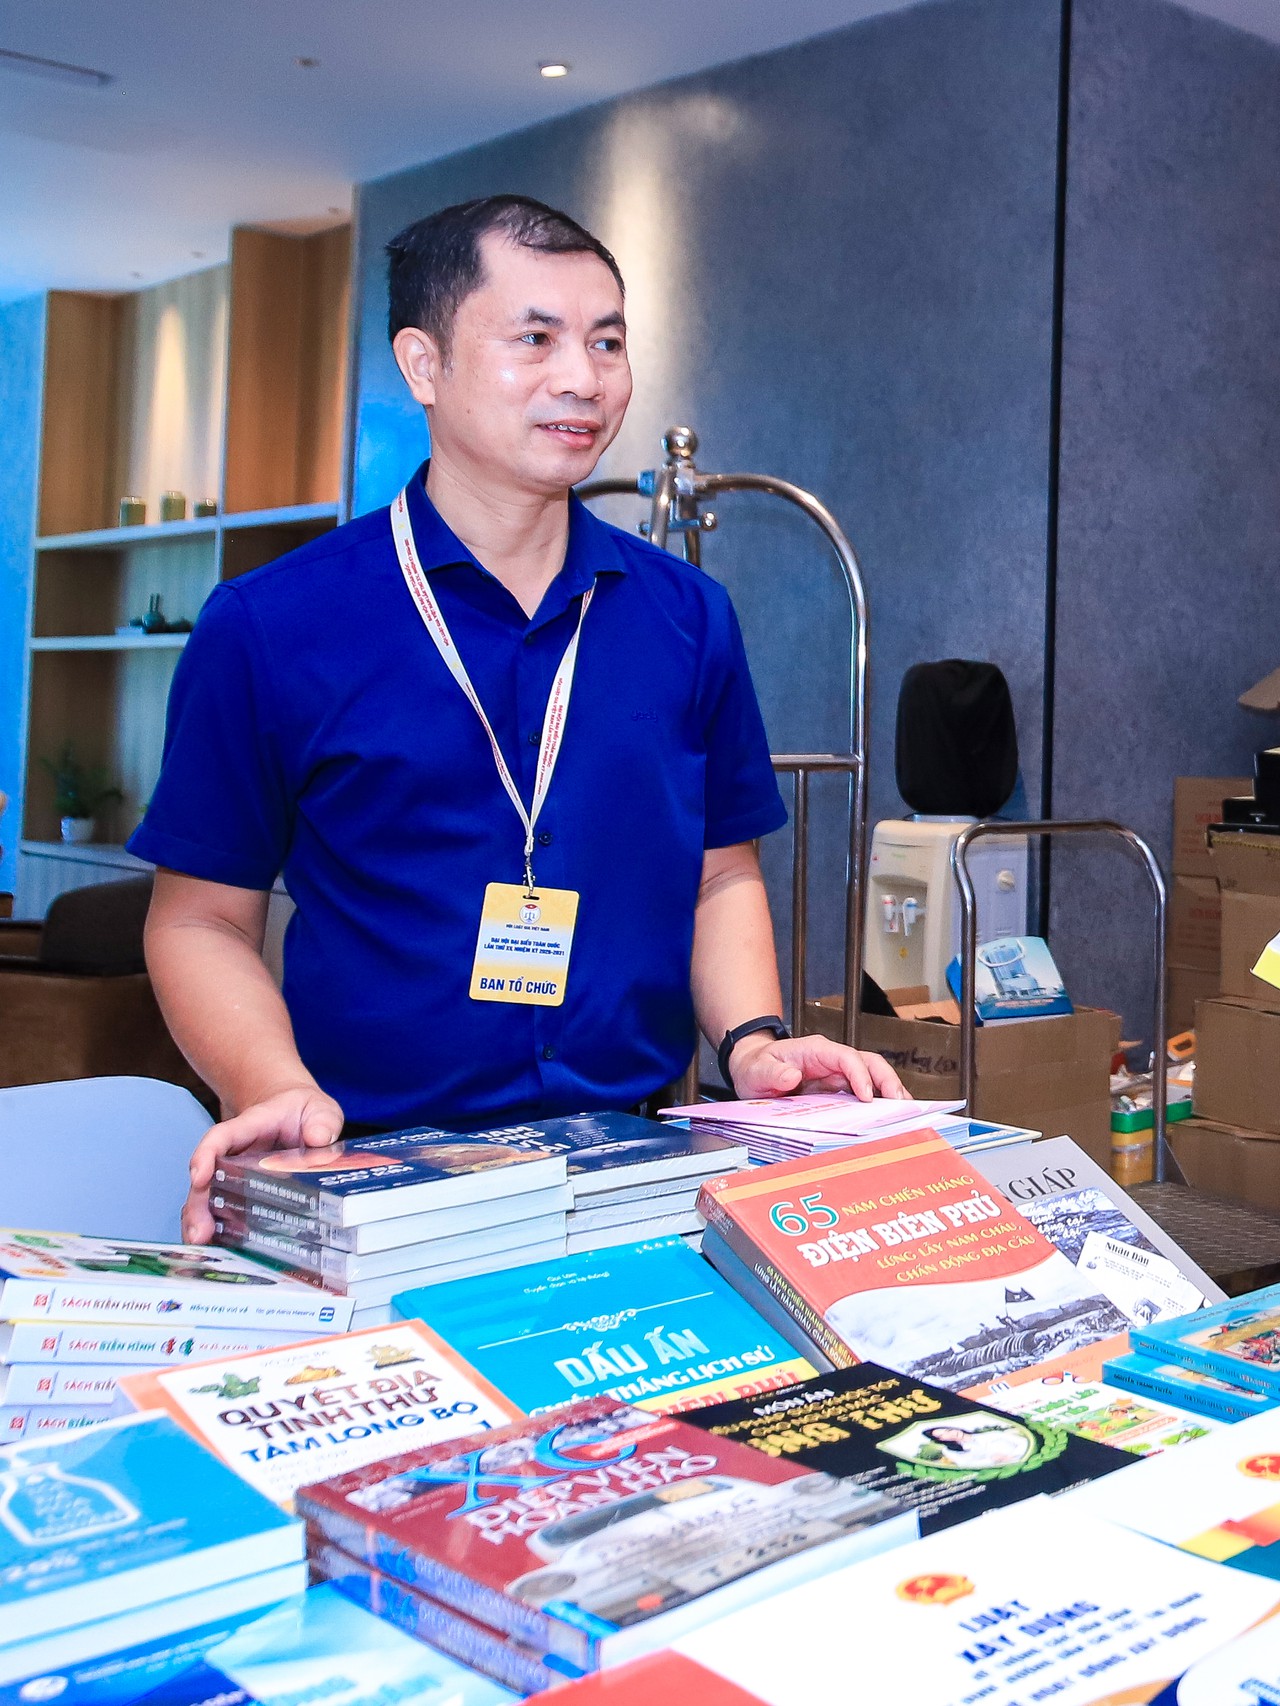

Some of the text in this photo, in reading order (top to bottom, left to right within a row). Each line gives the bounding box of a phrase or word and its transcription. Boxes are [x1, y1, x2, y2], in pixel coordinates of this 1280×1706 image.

[480, 976, 557, 995] BAN TỔ CHỨC
[1008, 1166, 1076, 1200] GIÁP
[768, 1174, 975, 1236] 65 NĂM CHIẾN THẮNG
[796, 1230, 870, 1268] ĐIỆN
[872, 1206, 948, 1248] BIÊN
[940, 1190, 1002, 1227] PHỦ
[876, 1221, 1024, 1270] LỪNG LẪY NĂM CHÂU,
[895, 1232, 1036, 1283] CHẤN ĐỘNG ĐỊA CẦU
[1105, 1241, 1149, 1268] Nhân Dân
[62, 1295, 152, 1311] SÁCH BIẾN HÌNH
[766, 1265, 774, 1275] 65
[773, 1273, 788, 1291] NĂM
[787, 1288, 805, 1311] CHIẾN
[804, 1307, 824, 1332] THẮNG
[824, 1327, 839, 1348] ĐIỆN
[69, 1337, 157, 1351] SÁCH BIẾN HÌNH
[554, 1325, 710, 1388] DẤU ẤN
[64, 1380, 93, 1391] SÁCH
[606, 1346, 776, 1400] THẮNG LỊCH SỬ
[217, 1369, 443, 1427] QUYẾT ĐỊA
[753, 1388, 835, 1416] MÓN ĂN
[38, 1416, 66, 1428] SÁCH
[246, 1403, 346, 1440] TINH
[327, 1414, 426, 1443] LONG
